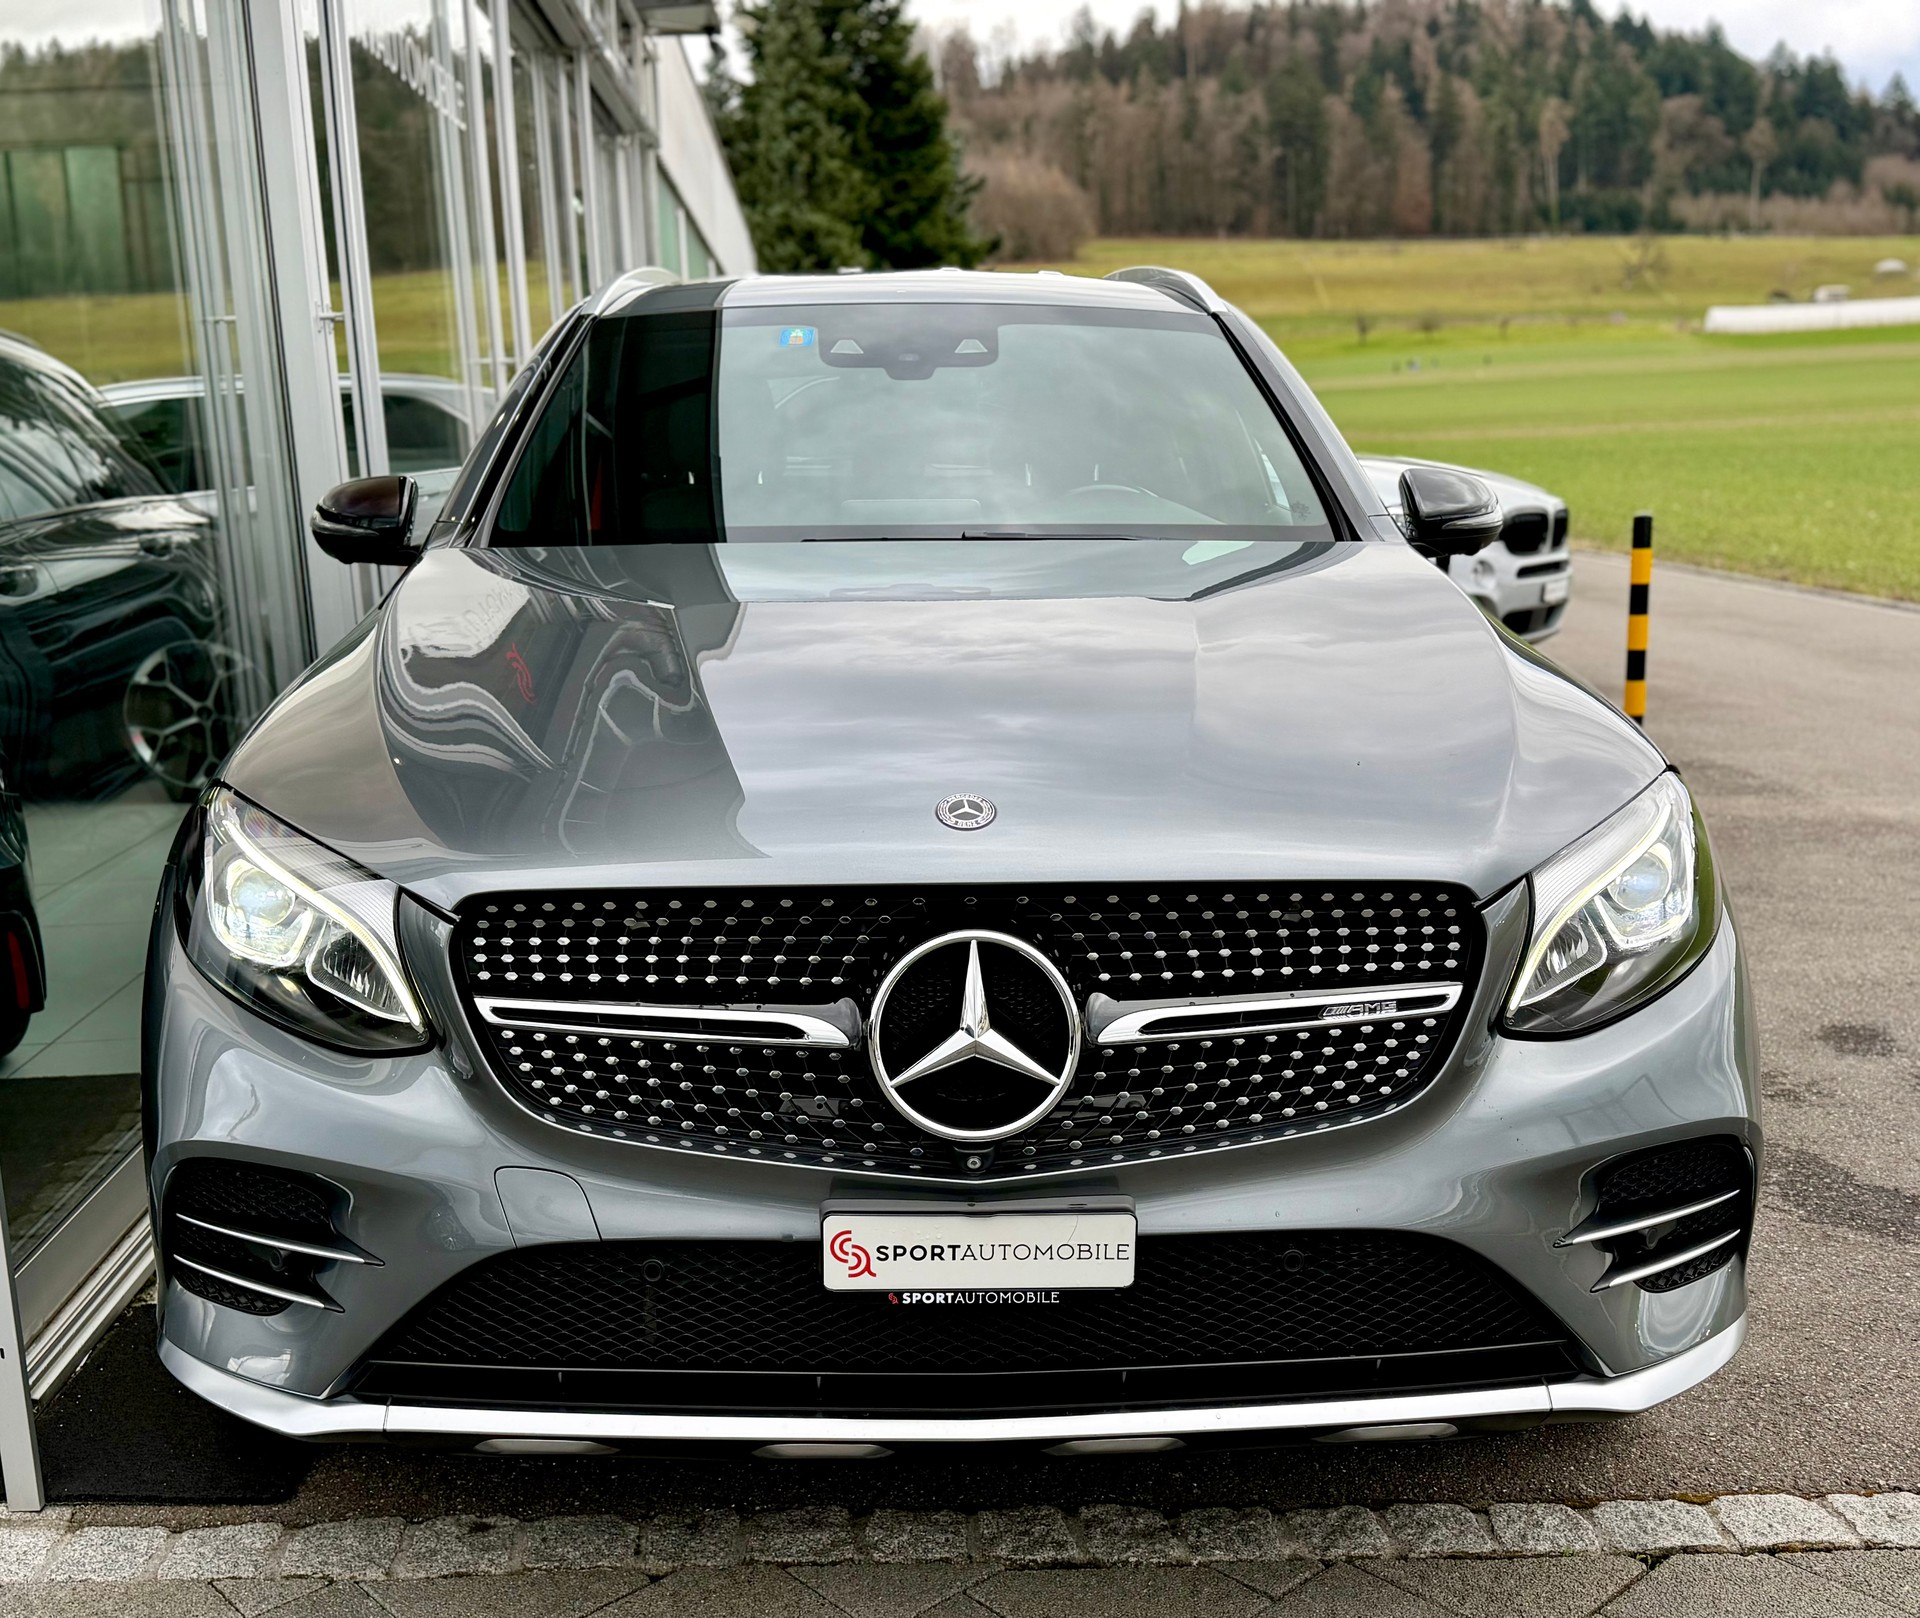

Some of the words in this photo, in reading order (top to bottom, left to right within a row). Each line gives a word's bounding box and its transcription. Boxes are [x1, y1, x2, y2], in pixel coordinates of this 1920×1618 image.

[1347, 1001, 1397, 1015] AMG
[875, 1243, 1130, 1262] SPORTAUTOMOBILE
[901, 1291, 1060, 1304] SPORTAUTOMOBILE
